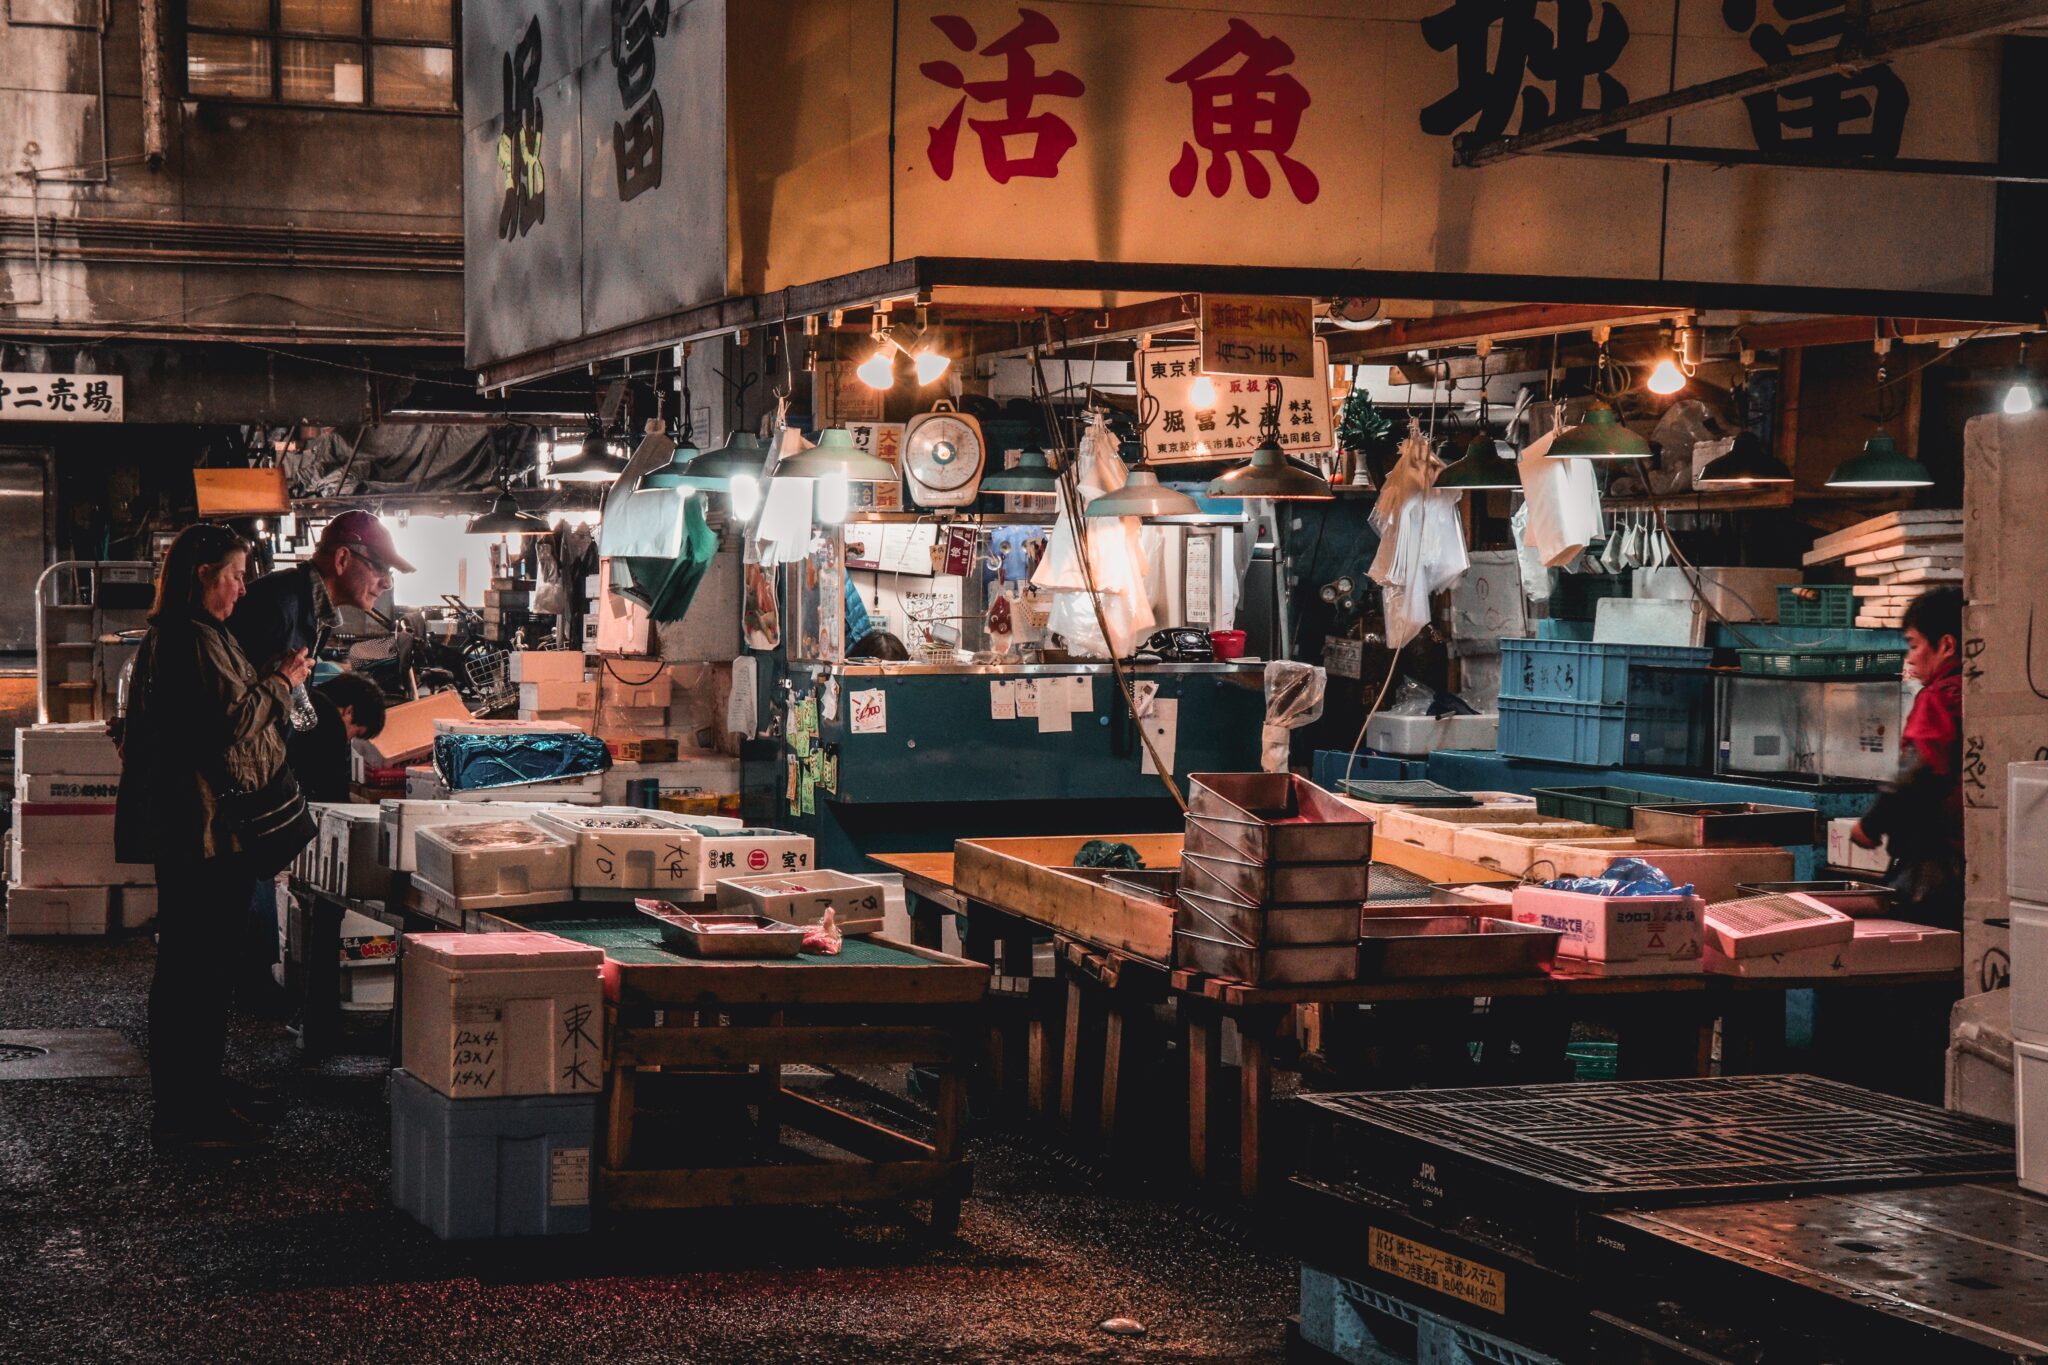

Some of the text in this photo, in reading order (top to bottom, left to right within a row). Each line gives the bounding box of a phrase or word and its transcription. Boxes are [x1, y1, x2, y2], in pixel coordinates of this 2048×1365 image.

[919, 8, 1320, 205] 活魚
[1216, 339, 1299, 367] 有ります
[719, 851, 736, 868] 根
[782, 851, 798, 868] 室
[1419, 1162, 1436, 1182] JPR
